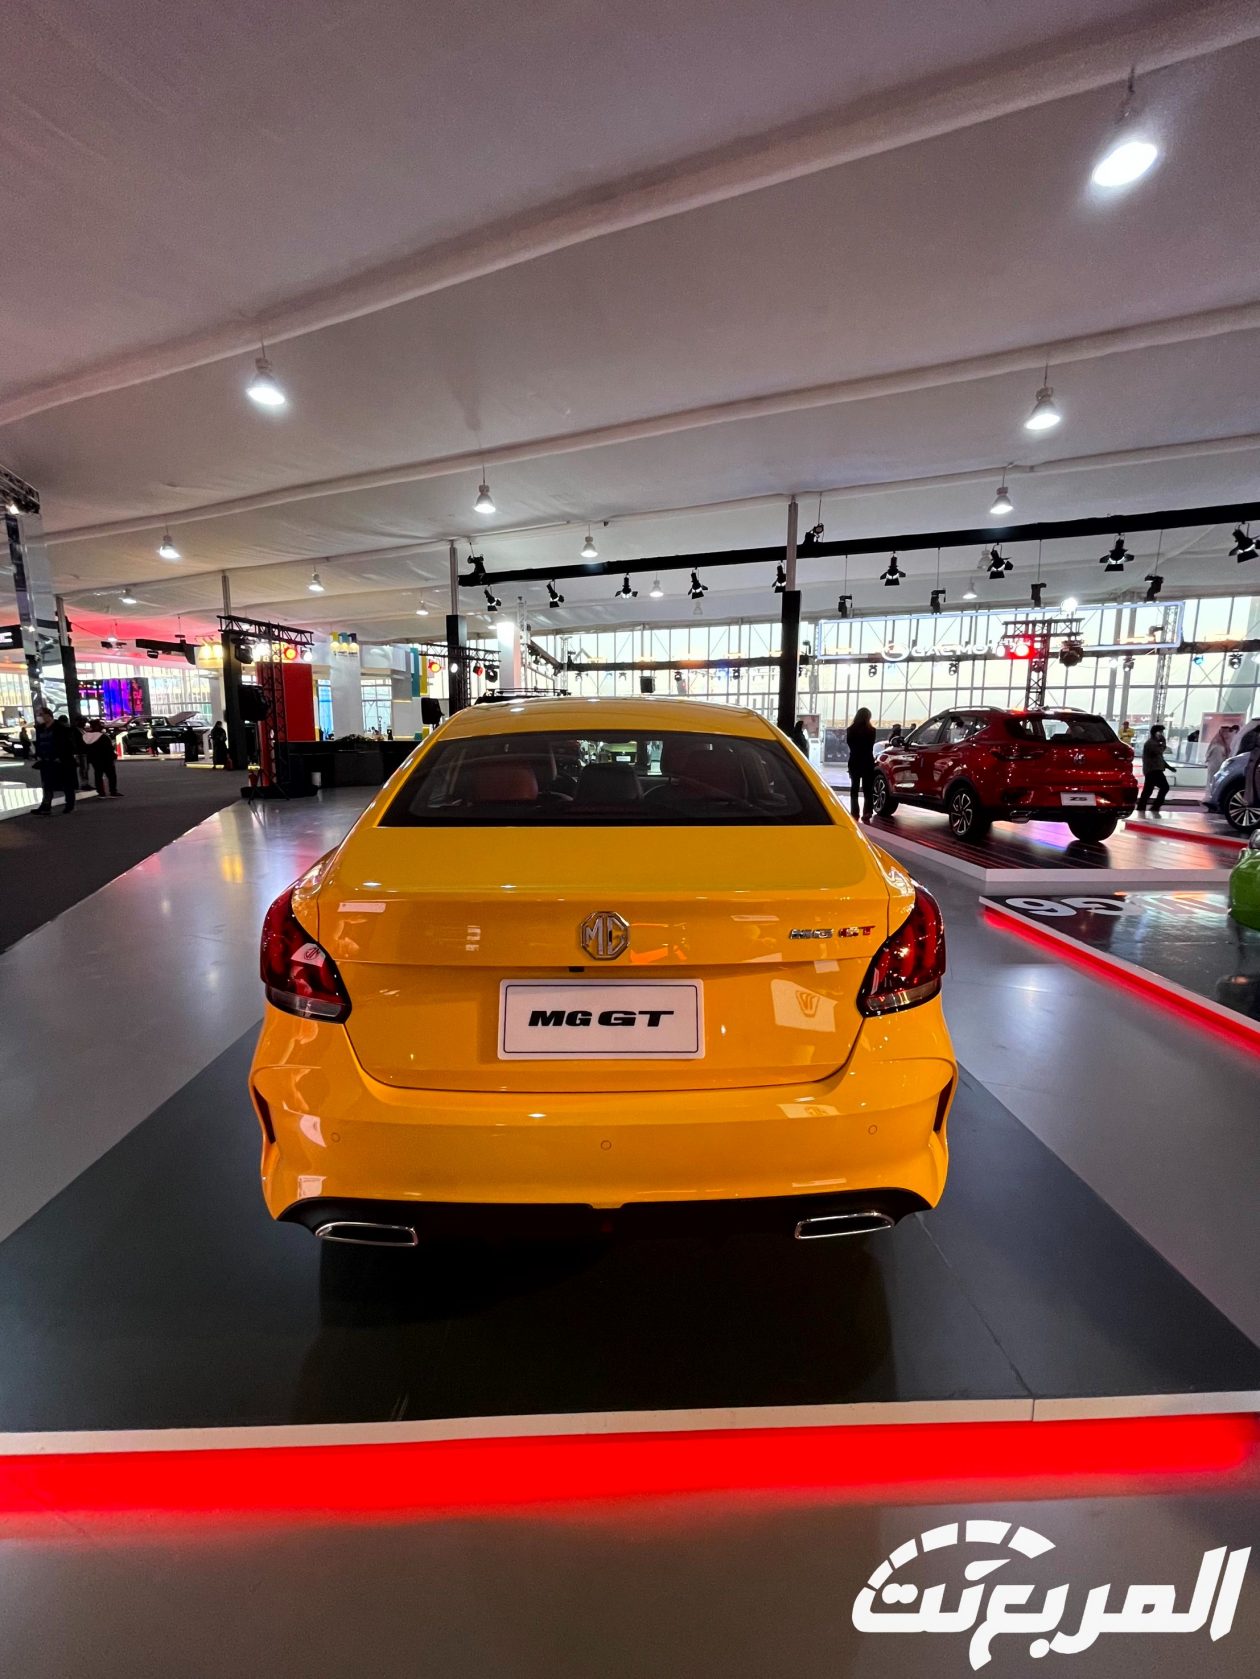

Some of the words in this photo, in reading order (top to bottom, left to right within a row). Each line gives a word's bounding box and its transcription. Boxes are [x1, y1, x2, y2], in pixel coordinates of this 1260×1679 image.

[583, 914, 628, 958] MG
[789, 928, 834, 940] MG
[838, 925, 876, 938] GT
[528, 1010, 593, 1027] MG
[598, 1010, 675, 1027] GT
